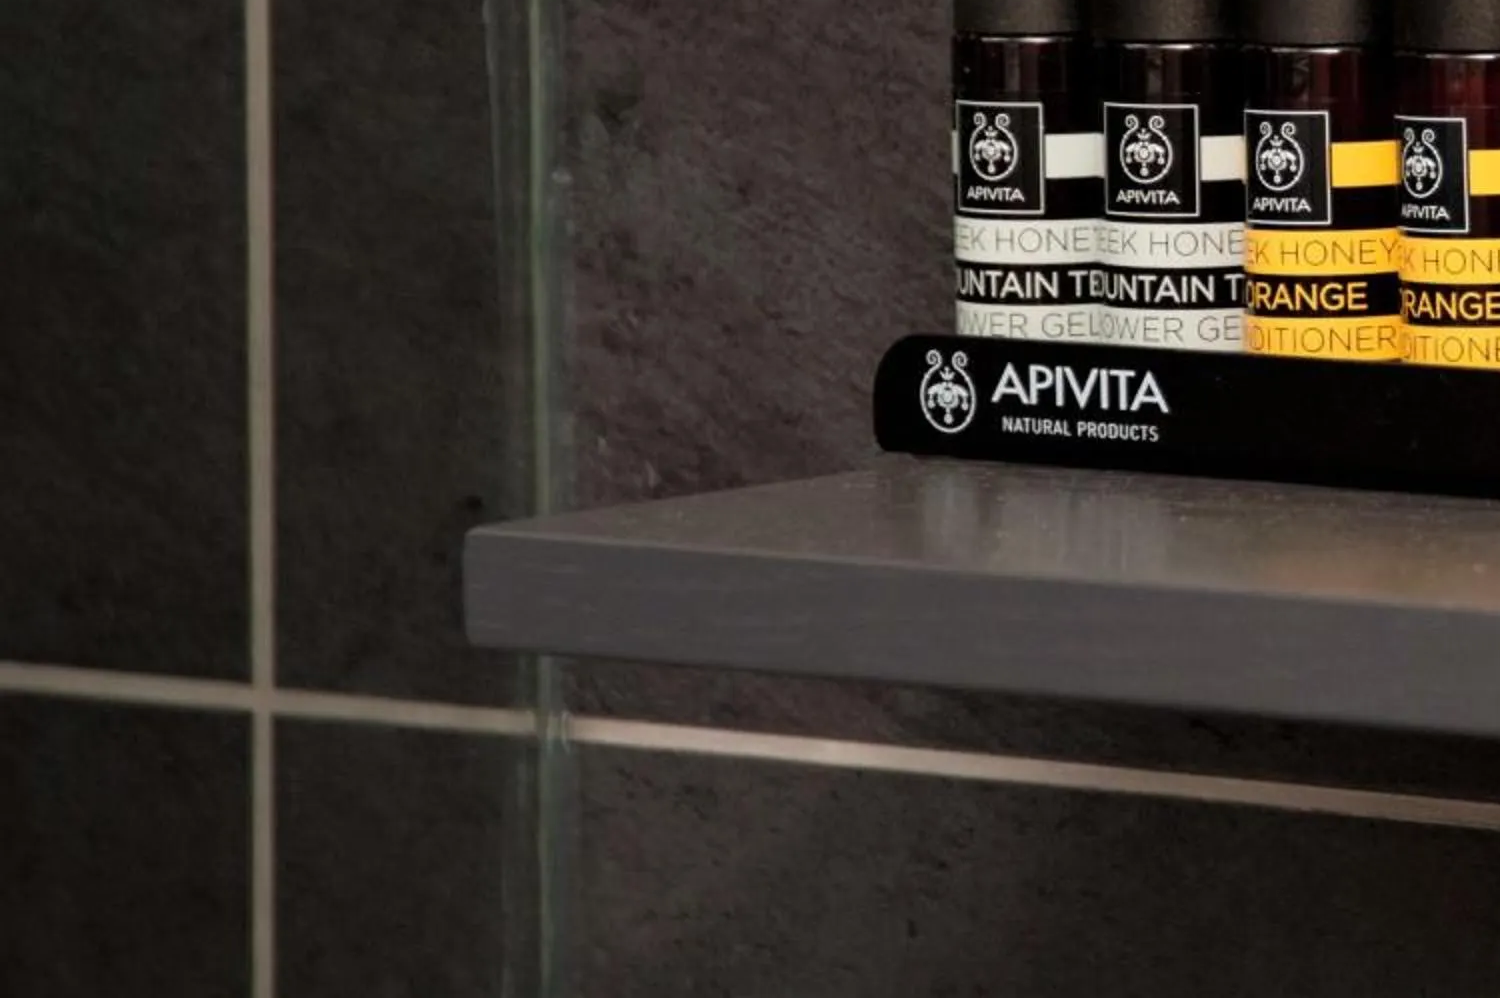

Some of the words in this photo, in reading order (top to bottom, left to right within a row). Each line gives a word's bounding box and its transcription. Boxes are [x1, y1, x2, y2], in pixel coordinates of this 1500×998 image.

[966, 186, 1025, 202] APIVITA
[1116, 189, 1180, 205] APIVITA
[1253, 197, 1311, 213] APIVITA
[1280, 238, 1399, 267] HONEY
[991, 362, 1170, 414] APIVITA
[1001, 416, 1073, 438] NATURAL
[1076, 421, 1160, 443] PRODUCTS
